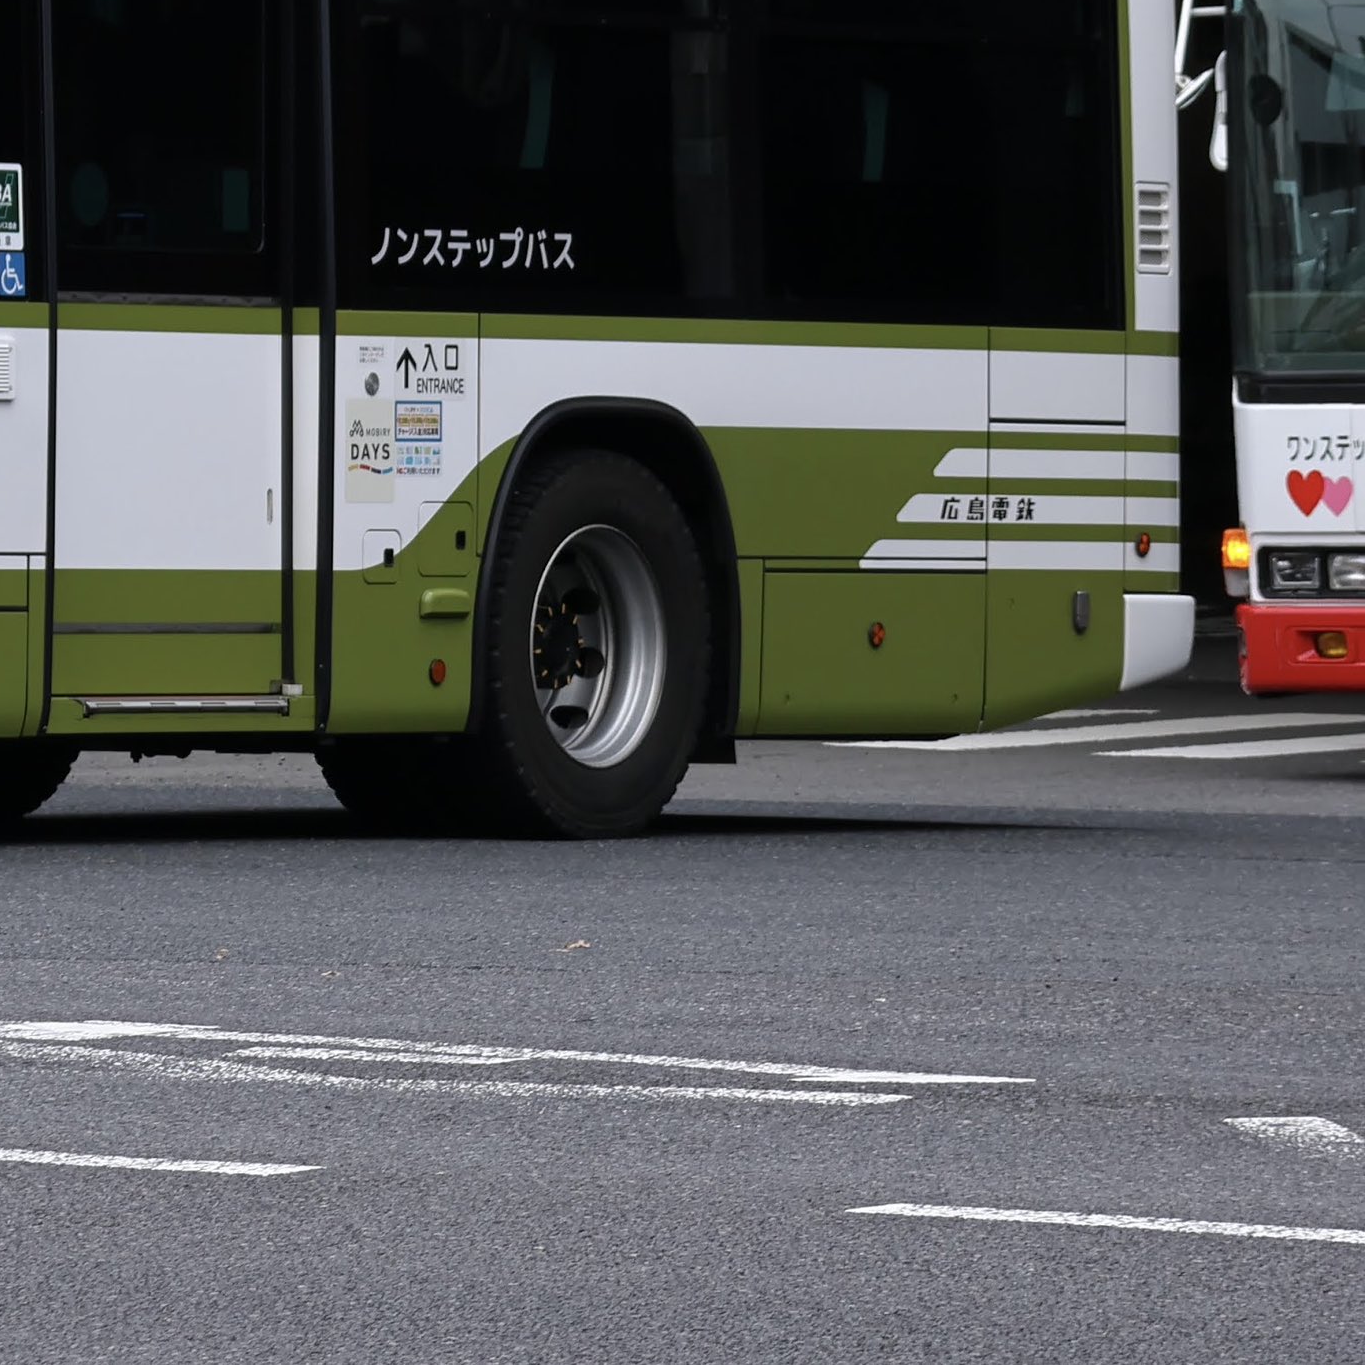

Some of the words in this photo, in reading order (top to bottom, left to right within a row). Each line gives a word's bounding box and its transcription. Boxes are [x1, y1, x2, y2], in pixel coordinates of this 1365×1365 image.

[371, 227, 575, 269] ノンステップバス
[422, 344, 458, 372] 入口
[416, 378, 464, 394] ENTRANCE
[366, 428, 390, 436] MOBIRY
[351, 443, 390, 460] DAYS
